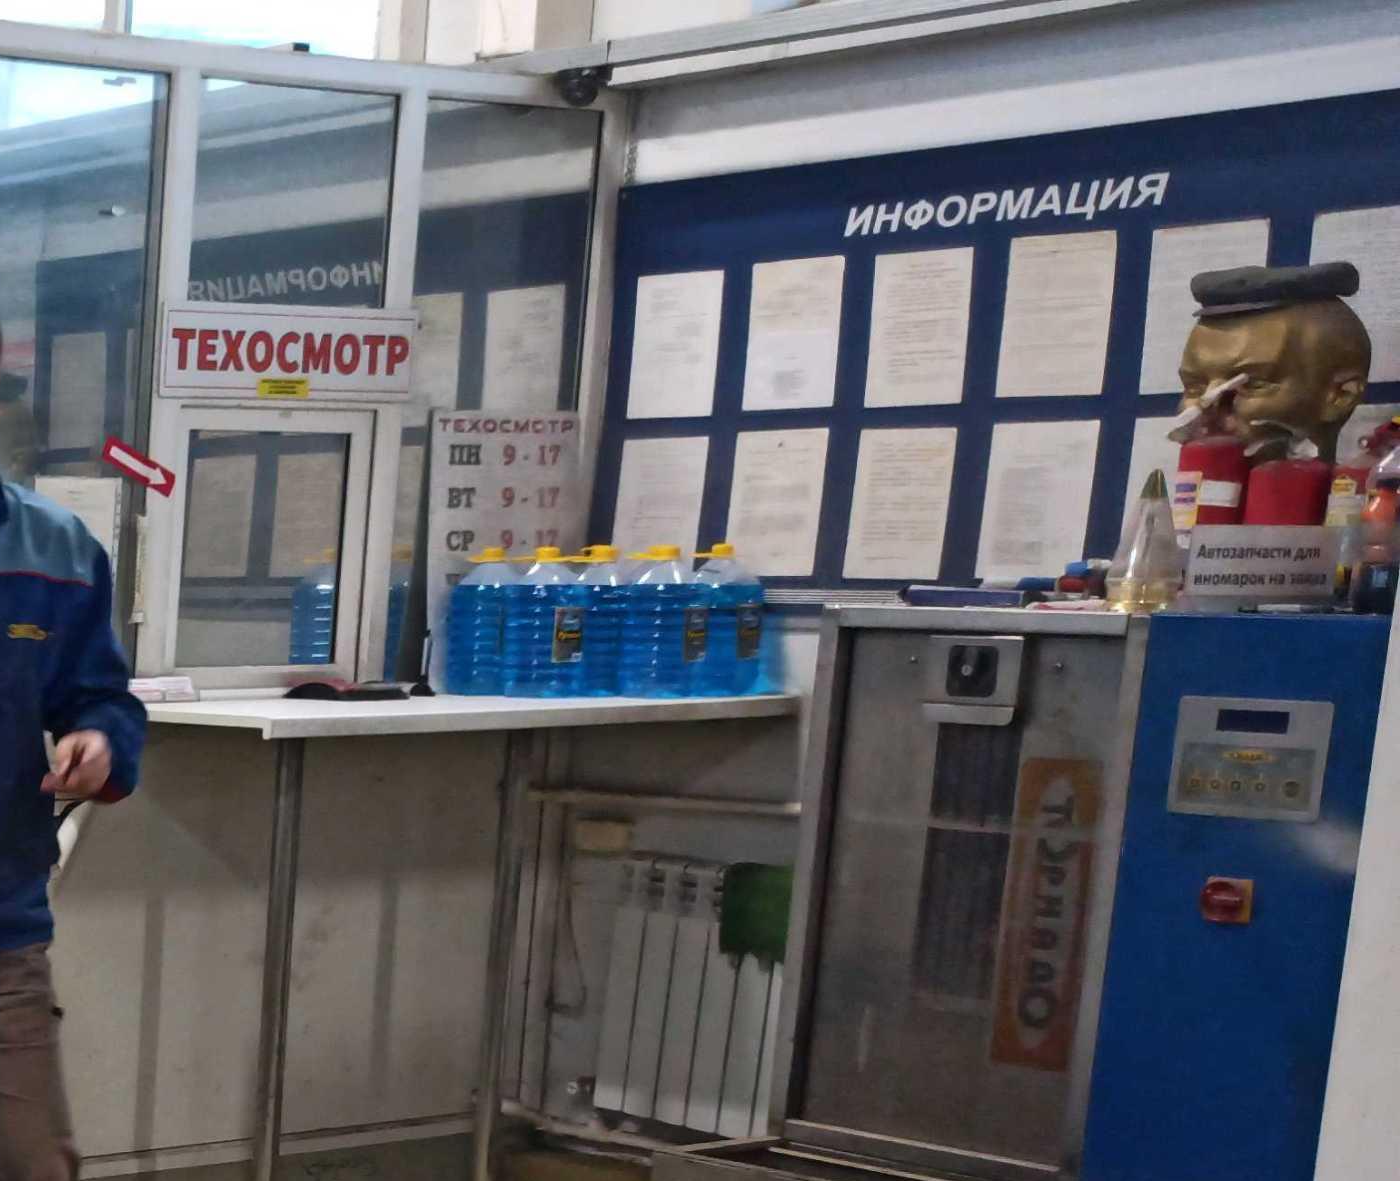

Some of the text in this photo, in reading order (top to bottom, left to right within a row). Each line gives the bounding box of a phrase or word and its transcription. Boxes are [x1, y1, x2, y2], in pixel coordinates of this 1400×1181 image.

[843, 172, 1170, 237] ИНФОРМАЦИЯ
[171, 327, 410, 376] ТЕХОСМОТР
[438, 418, 574, 433] ТЕХОСМОТР
[449, 444, 482, 465] ПН
[447, 487, 477, 508] ВТ
[446, 530, 475, 551] СР
[1198, 544, 1321, 561] Автозапчасти для
[1193, 573, 1266, 587] иномарок
[1269, 574, 1285, 584] на
